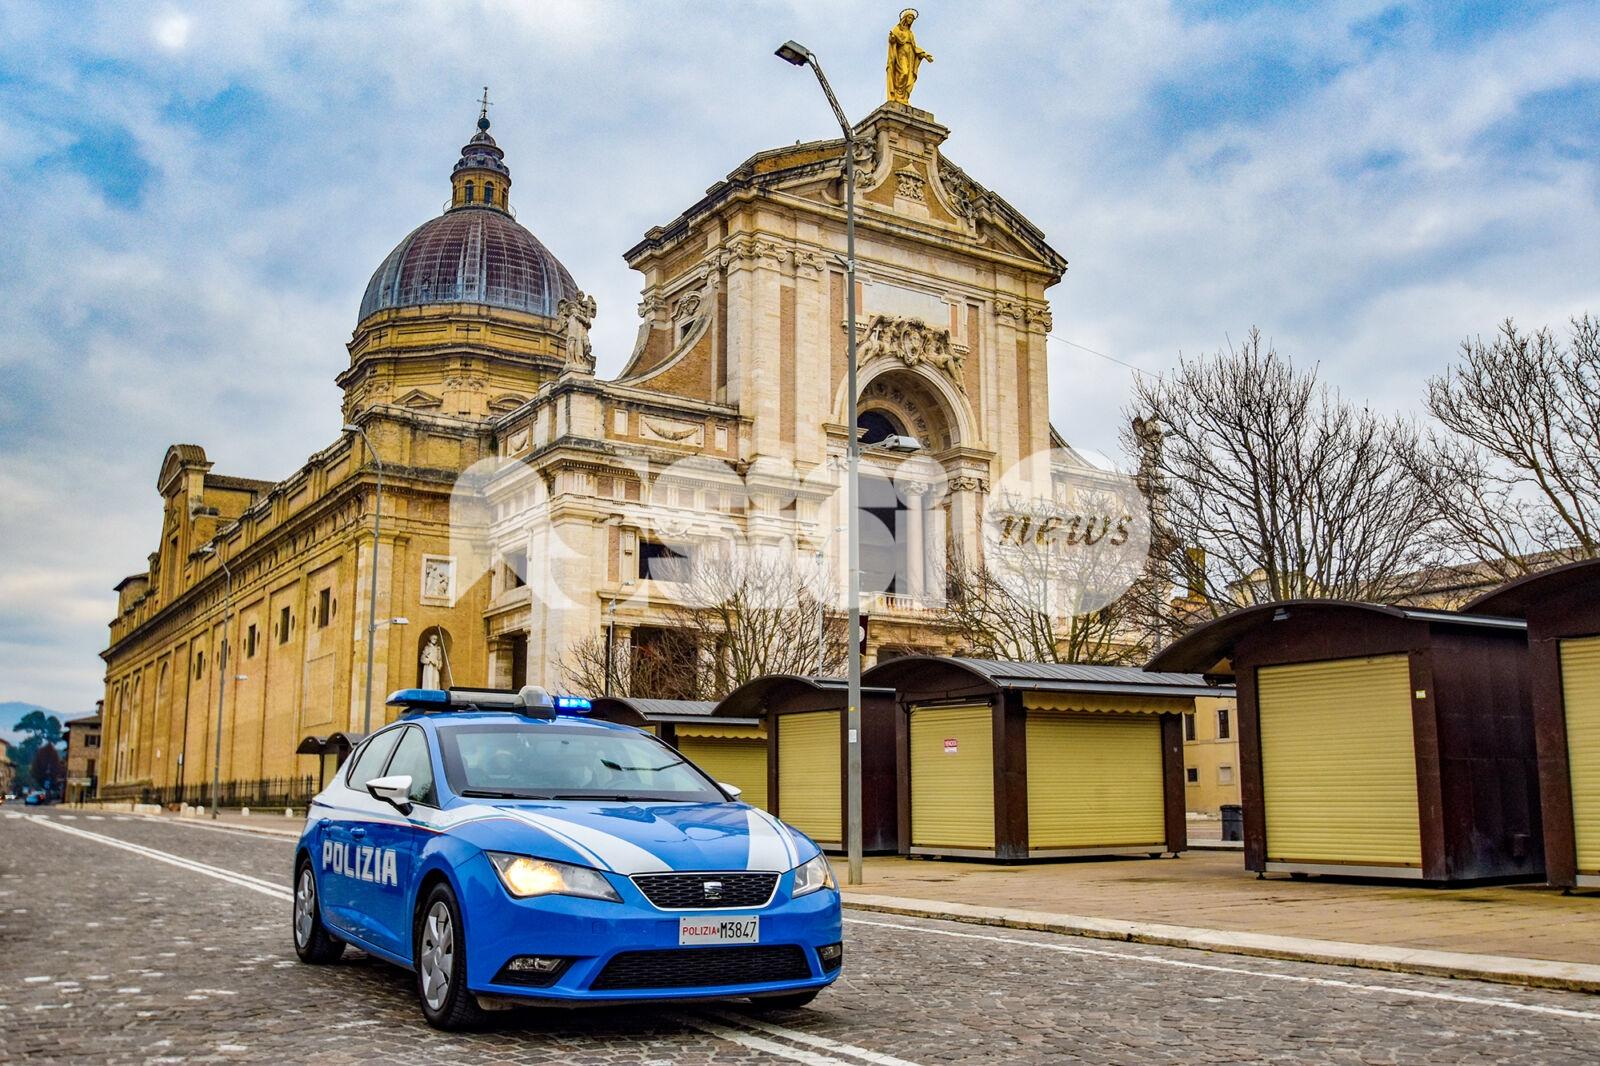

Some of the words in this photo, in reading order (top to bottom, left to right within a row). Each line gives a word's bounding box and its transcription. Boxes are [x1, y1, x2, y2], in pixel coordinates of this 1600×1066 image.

[322, 839, 398, 887] POLIZIA
[682, 926, 717, 936] POLIZIA
[720, 921, 757, 939] M3847
